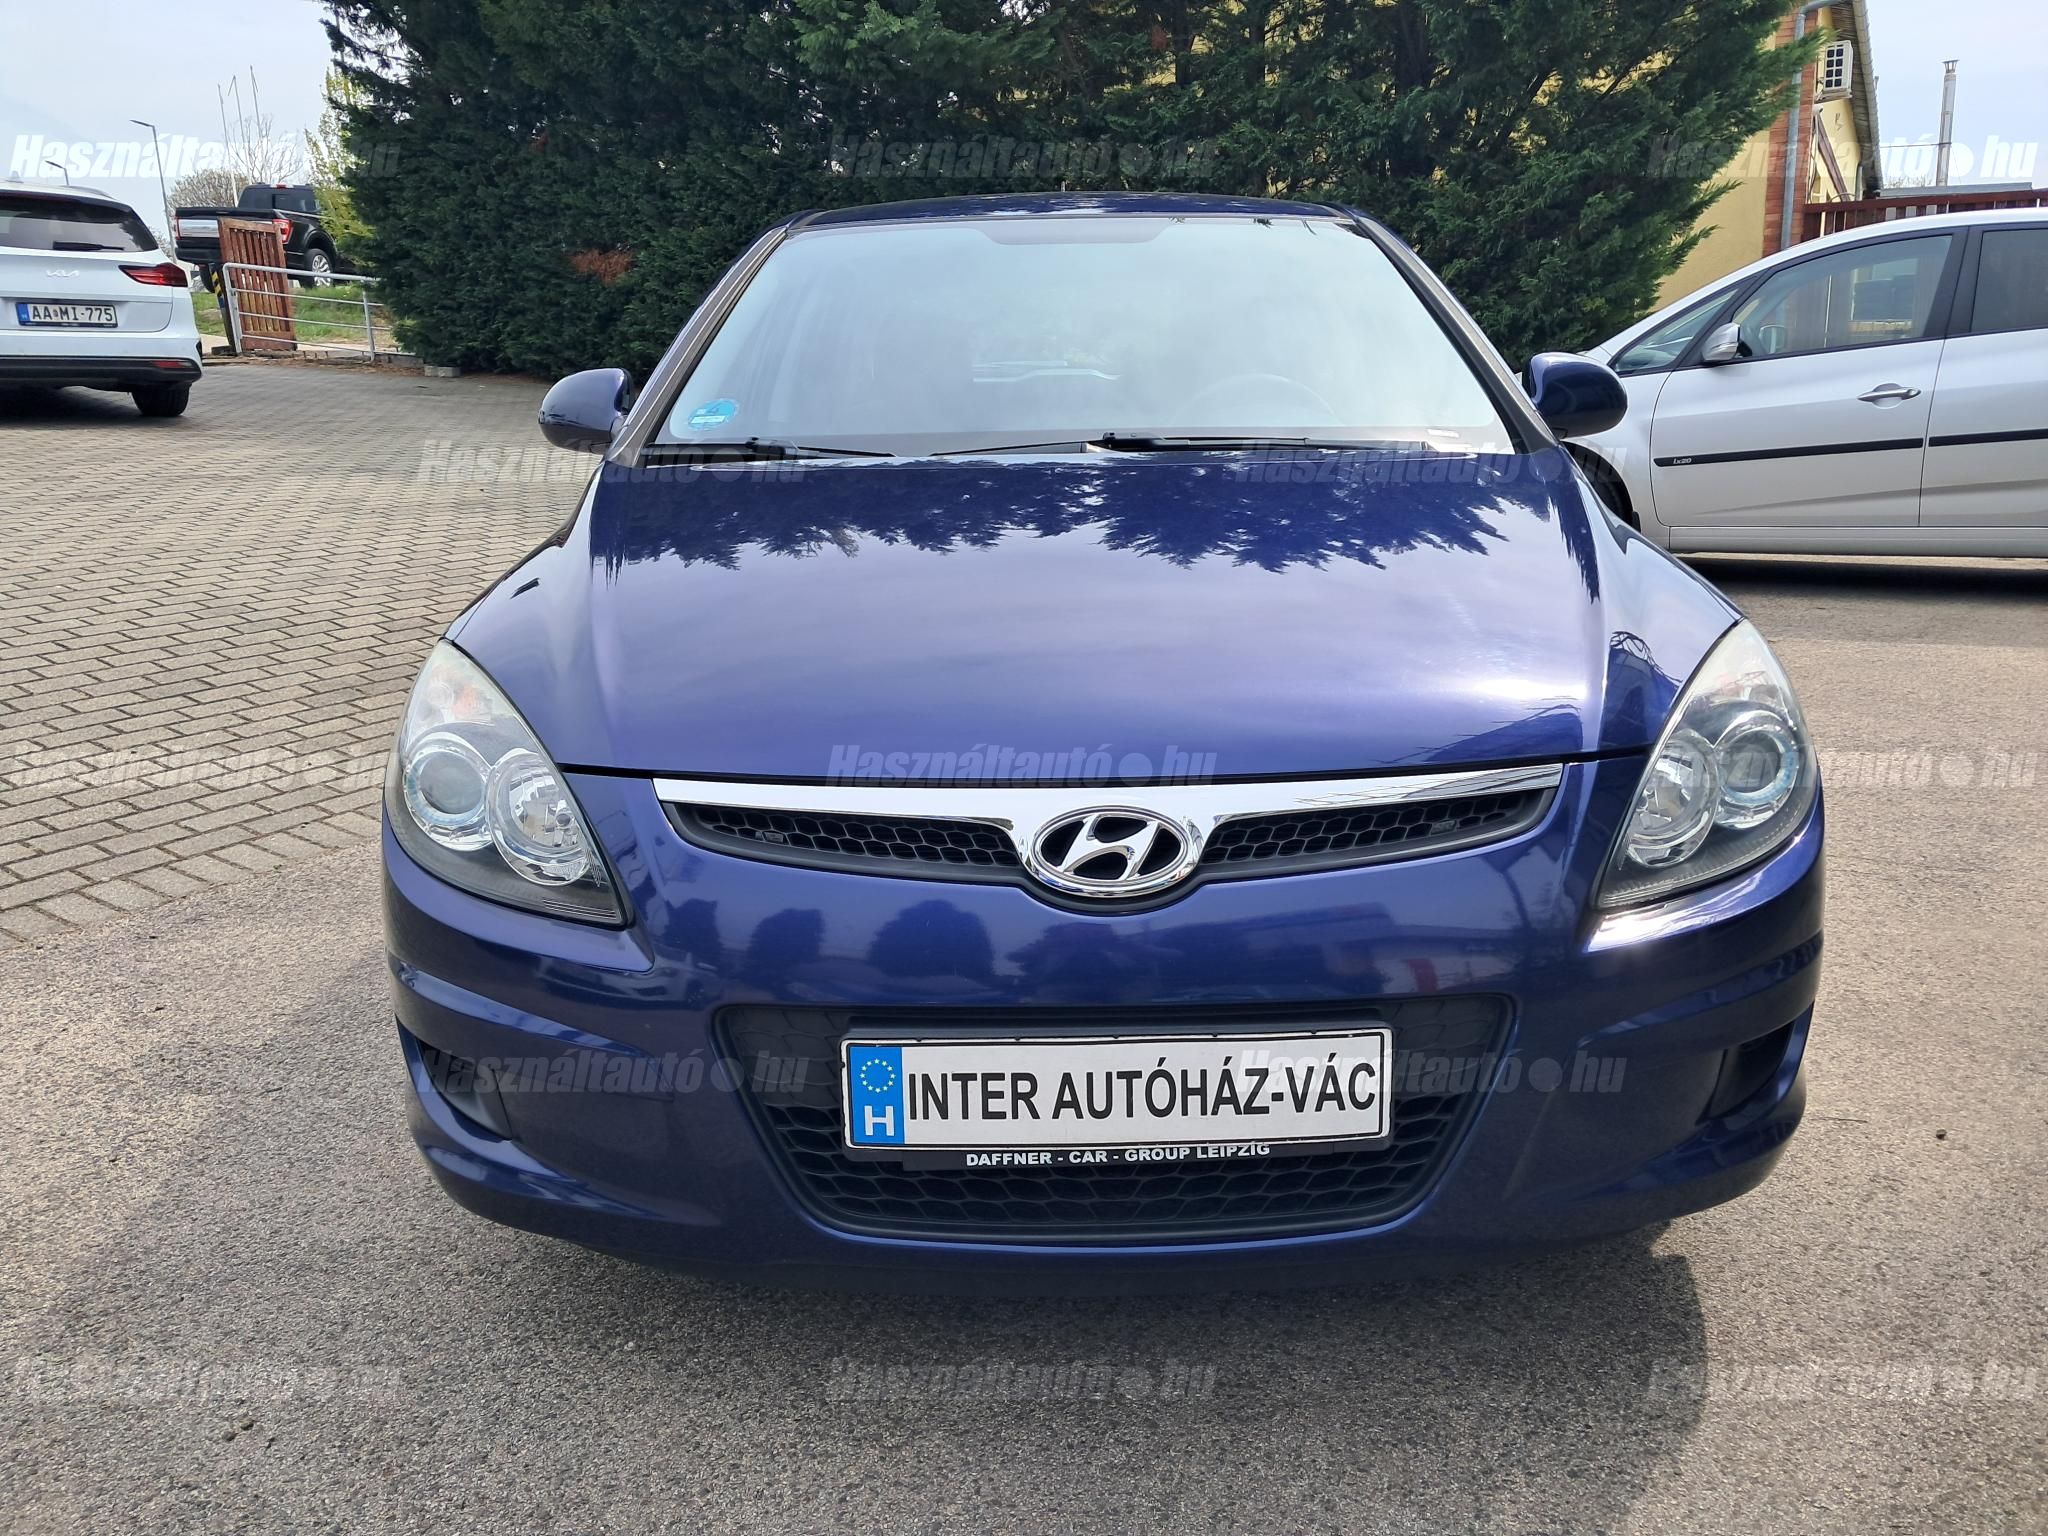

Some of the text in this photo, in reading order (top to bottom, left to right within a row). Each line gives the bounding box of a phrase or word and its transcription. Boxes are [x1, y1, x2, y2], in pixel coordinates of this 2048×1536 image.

[908, 1052, 1376, 1121] INTER AUTÓHÁZ-VÁC
[865, 1104, 895, 1137] H
[966, 1151, 1053, 1167] DAFFNER
[1069, 1149, 1108, 1165] CAR
[1124, 1146, 1191, 1162] GROUP
[1196, 1143, 1271, 1160] LEIPZIG
